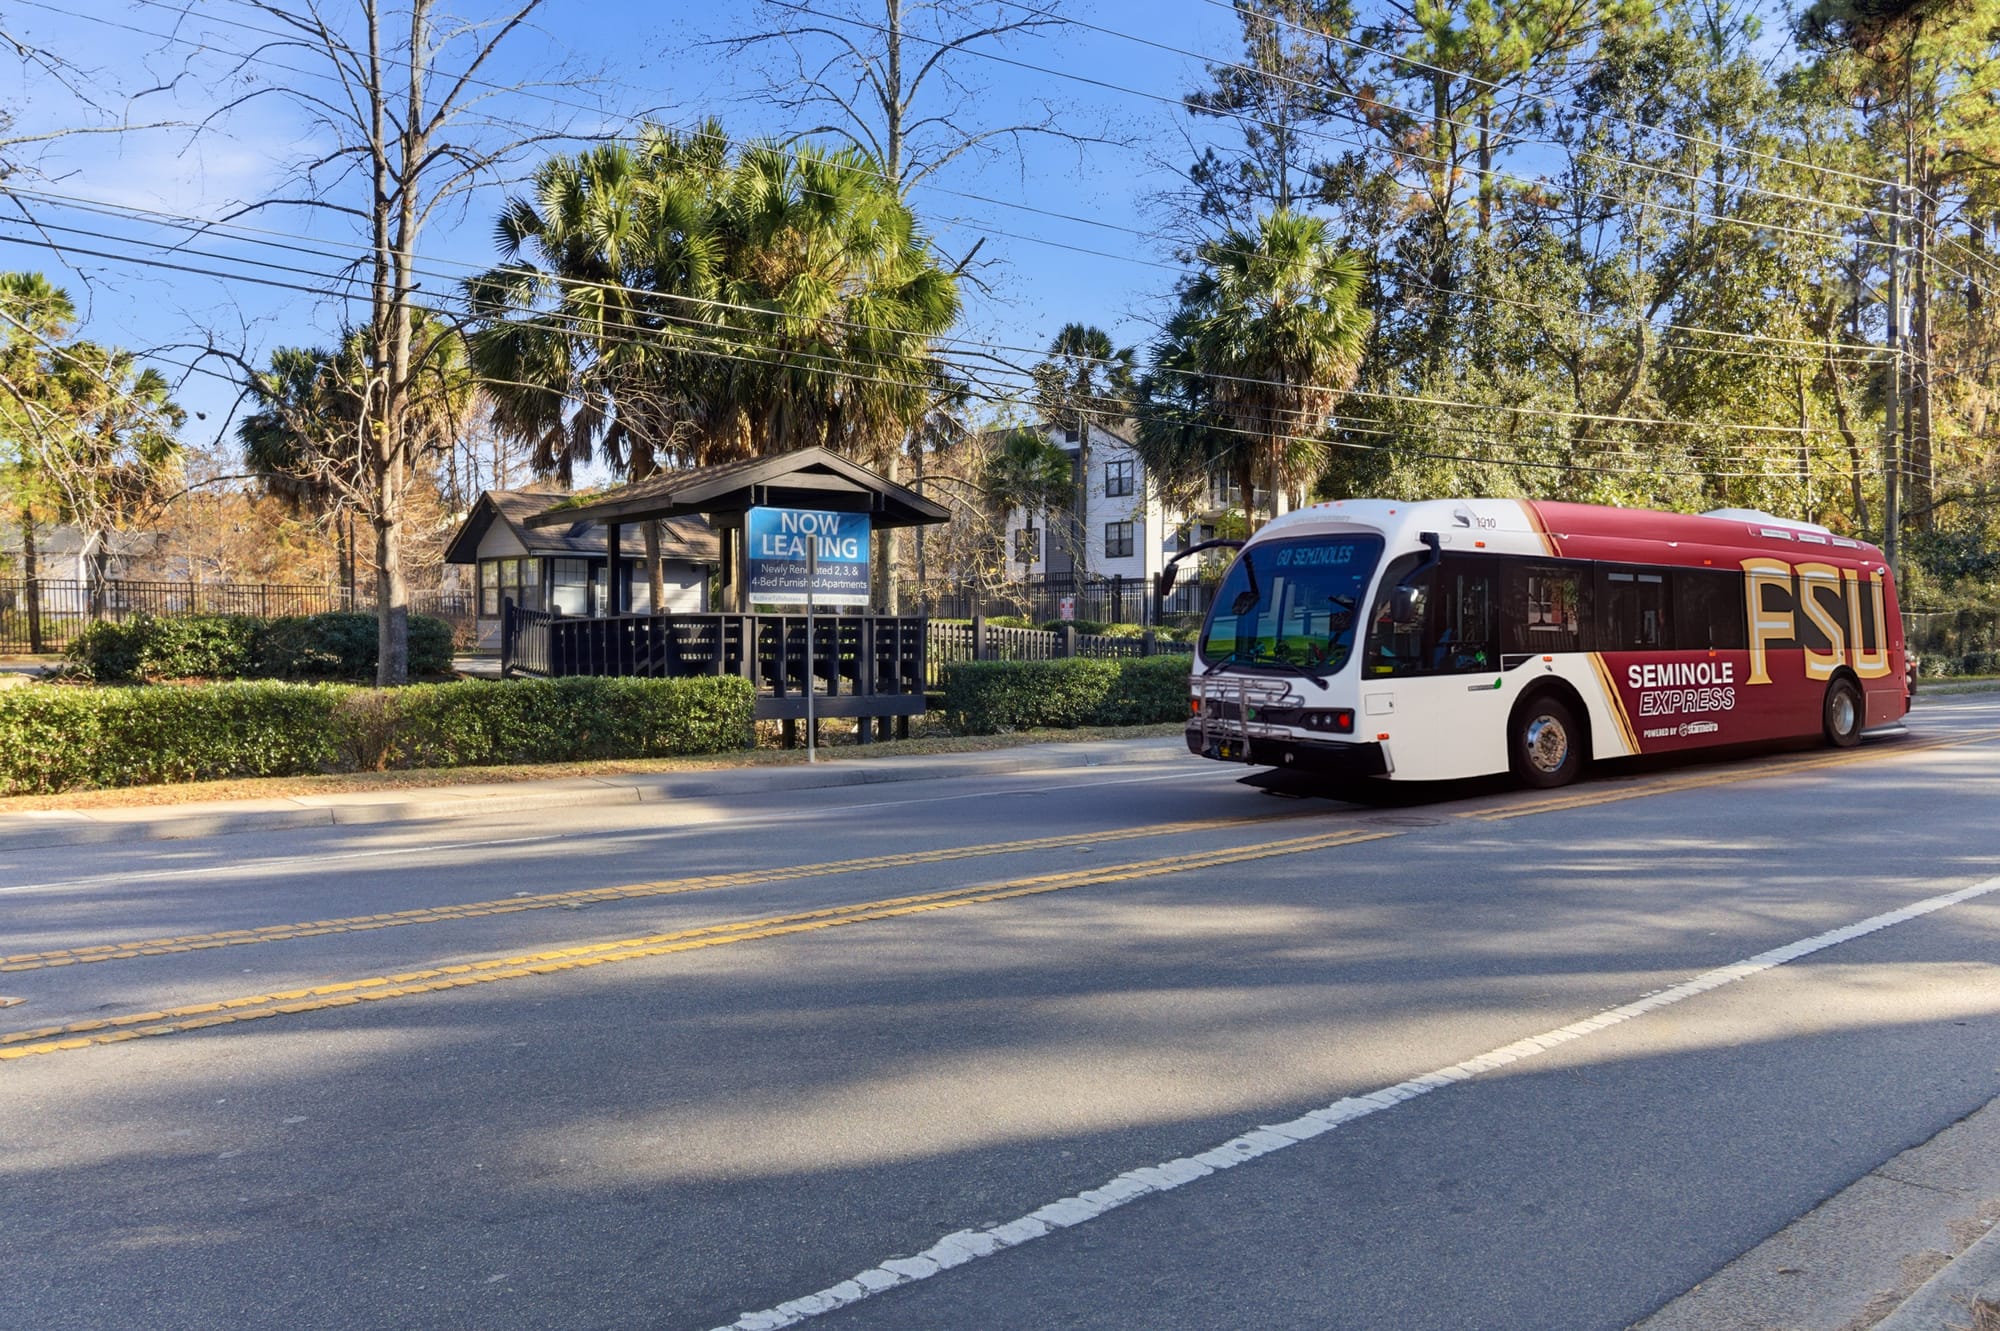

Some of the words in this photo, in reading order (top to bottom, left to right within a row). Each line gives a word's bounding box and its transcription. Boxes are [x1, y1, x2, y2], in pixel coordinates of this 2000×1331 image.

[781, 512, 841, 535] NOW
[762, 534, 858, 558] LEAING
[1277, 548, 1292, 566] GO
[1293, 545, 1354, 564] SEMINOLES
[761, 564, 788, 576] Newly
[852, 566, 859, 576] &
[821, 579, 867, 590] Apartments
[1739, 557, 1892, 685] FSU
[1628, 662, 1734, 688] SEMINOLE
[1639, 687, 1735, 716] EXPRESS
[1643, 728, 1669, 738] POWERED
[1670, 727, 1678, 736] BY
